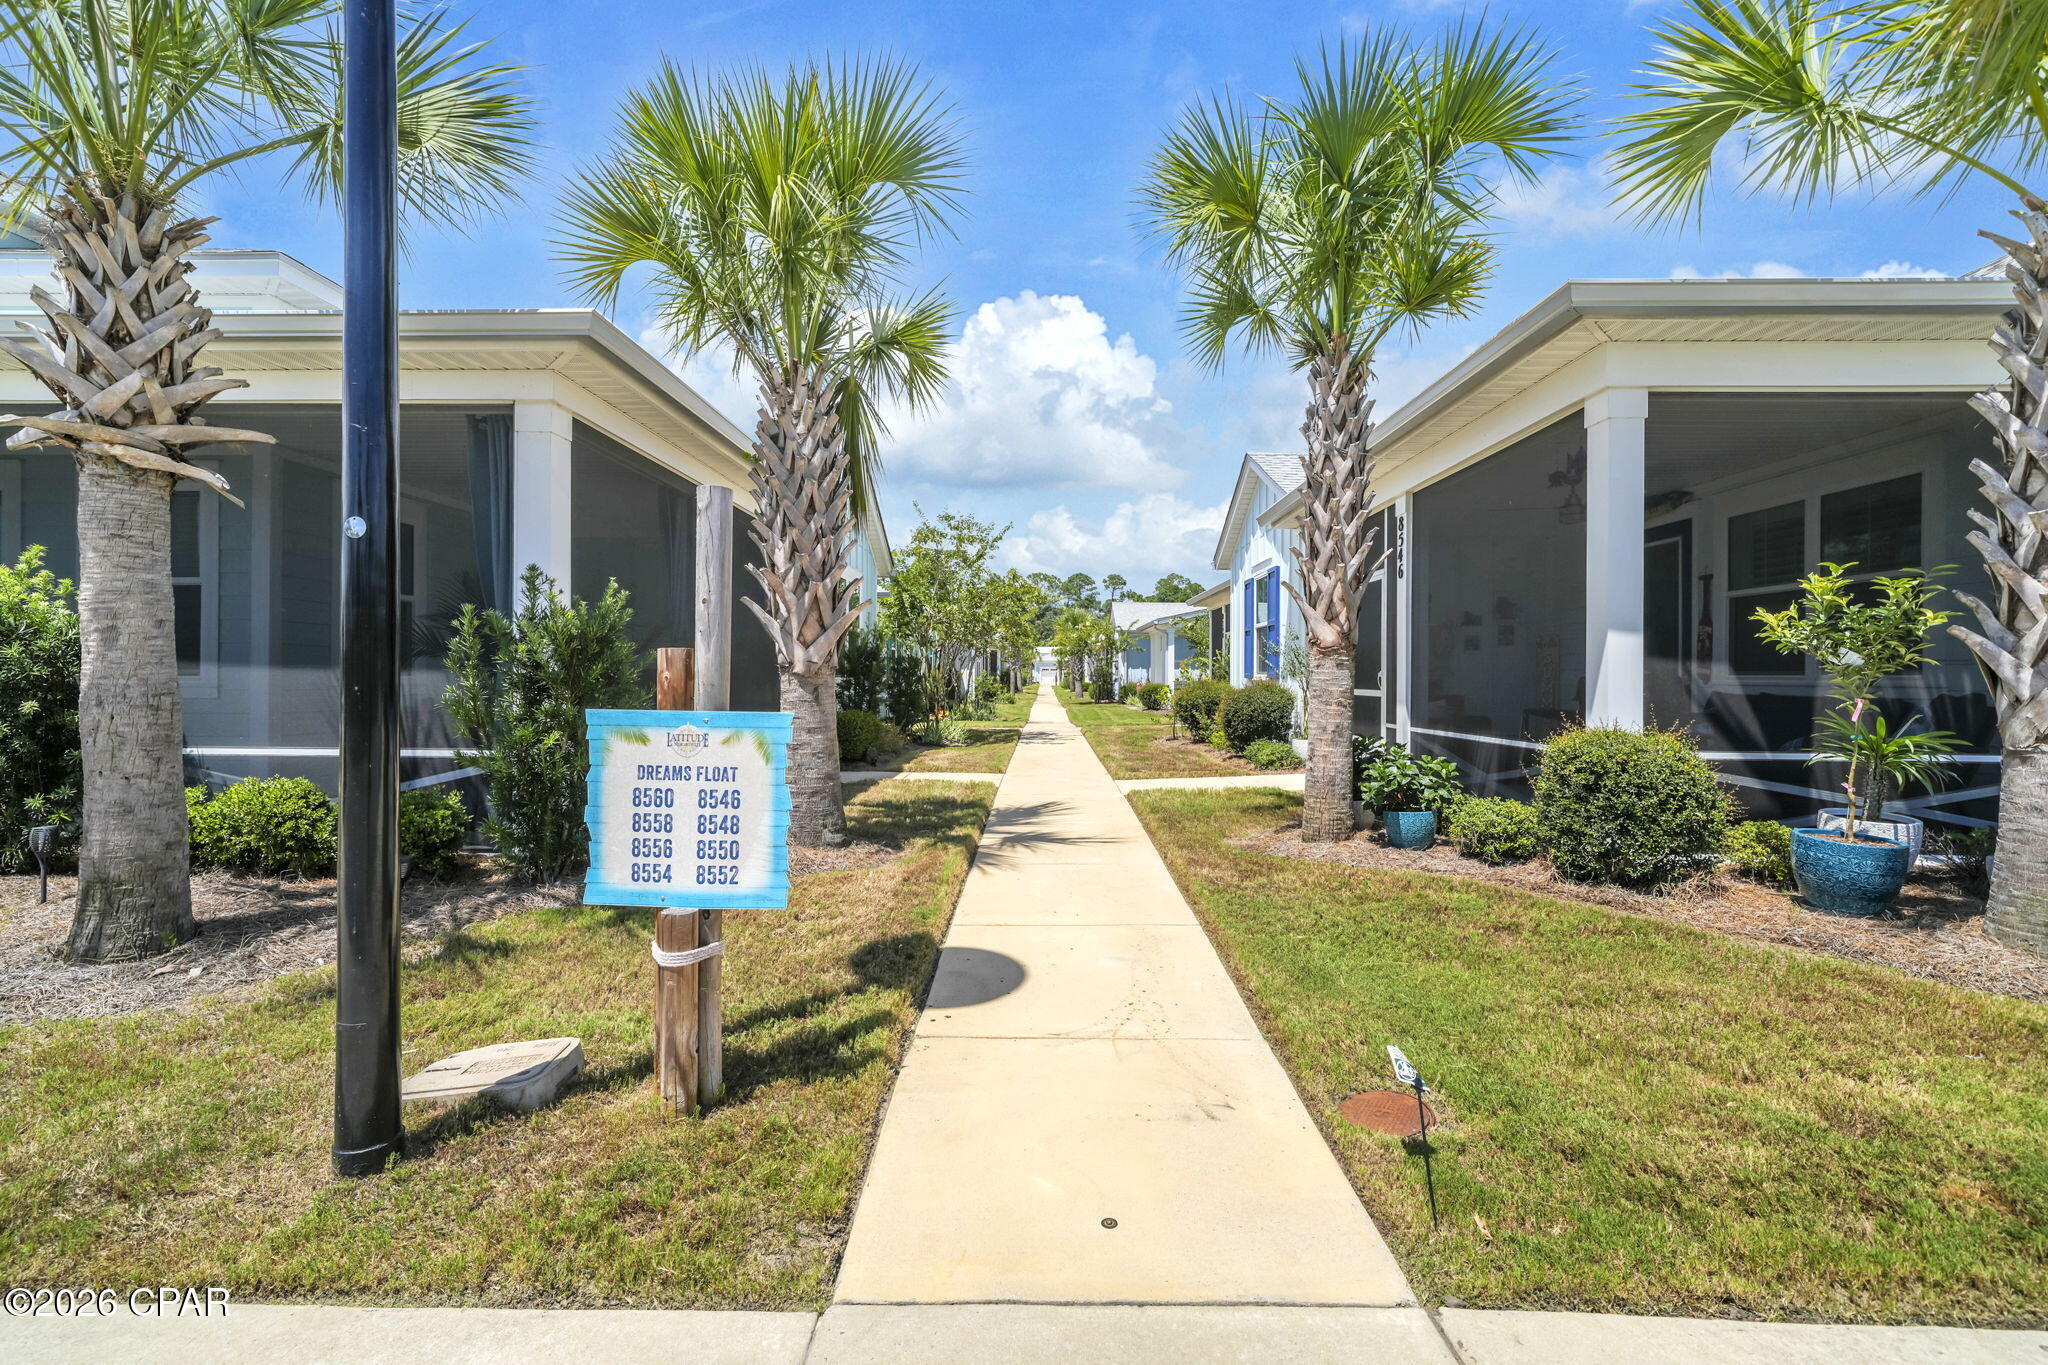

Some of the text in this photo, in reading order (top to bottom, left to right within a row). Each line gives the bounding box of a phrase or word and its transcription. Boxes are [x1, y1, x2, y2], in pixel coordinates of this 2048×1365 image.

[667, 732, 709, 748] LATITUDE
[638, 765, 738, 782] DREAMS FLOAT
[633, 787, 674, 808] 8560
[698, 789, 740, 809] 8546
[632, 813, 673, 833] 8558
[698, 815, 739, 834] 8548
[632, 838, 672, 858] 8556
[697, 840, 739, 860] 8550
[632, 863, 672, 883] 8554
[697, 865, 738, 884] 8552
